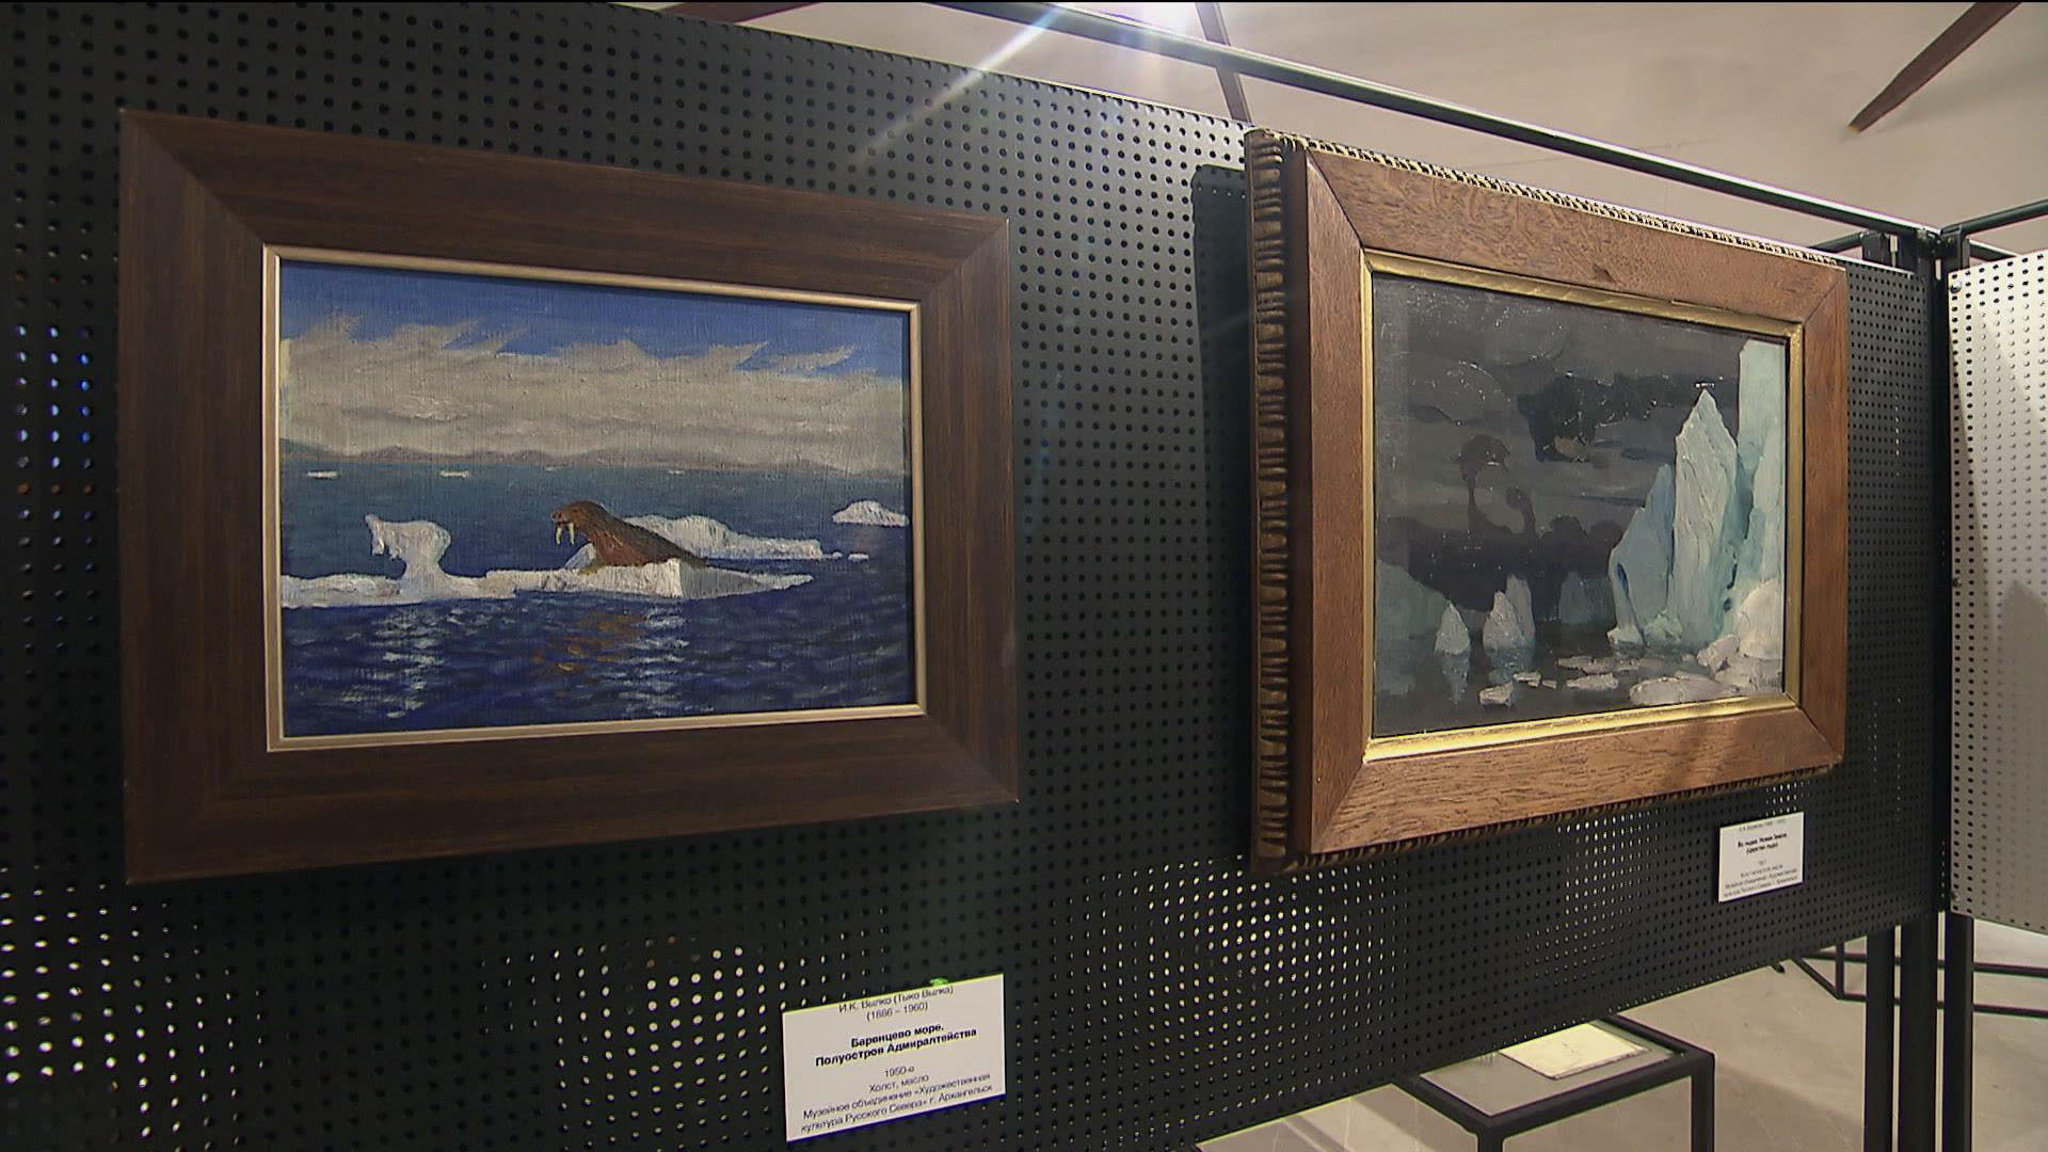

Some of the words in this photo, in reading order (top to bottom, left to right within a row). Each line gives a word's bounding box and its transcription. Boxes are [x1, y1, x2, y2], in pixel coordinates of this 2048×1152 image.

[815, 1046, 885, 1067] Полуостров
[886, 1027, 978, 1053] Адмиралтейства
[850, 1029, 912, 1048] Баренцево
[844, 1105, 888, 1124] Русского
